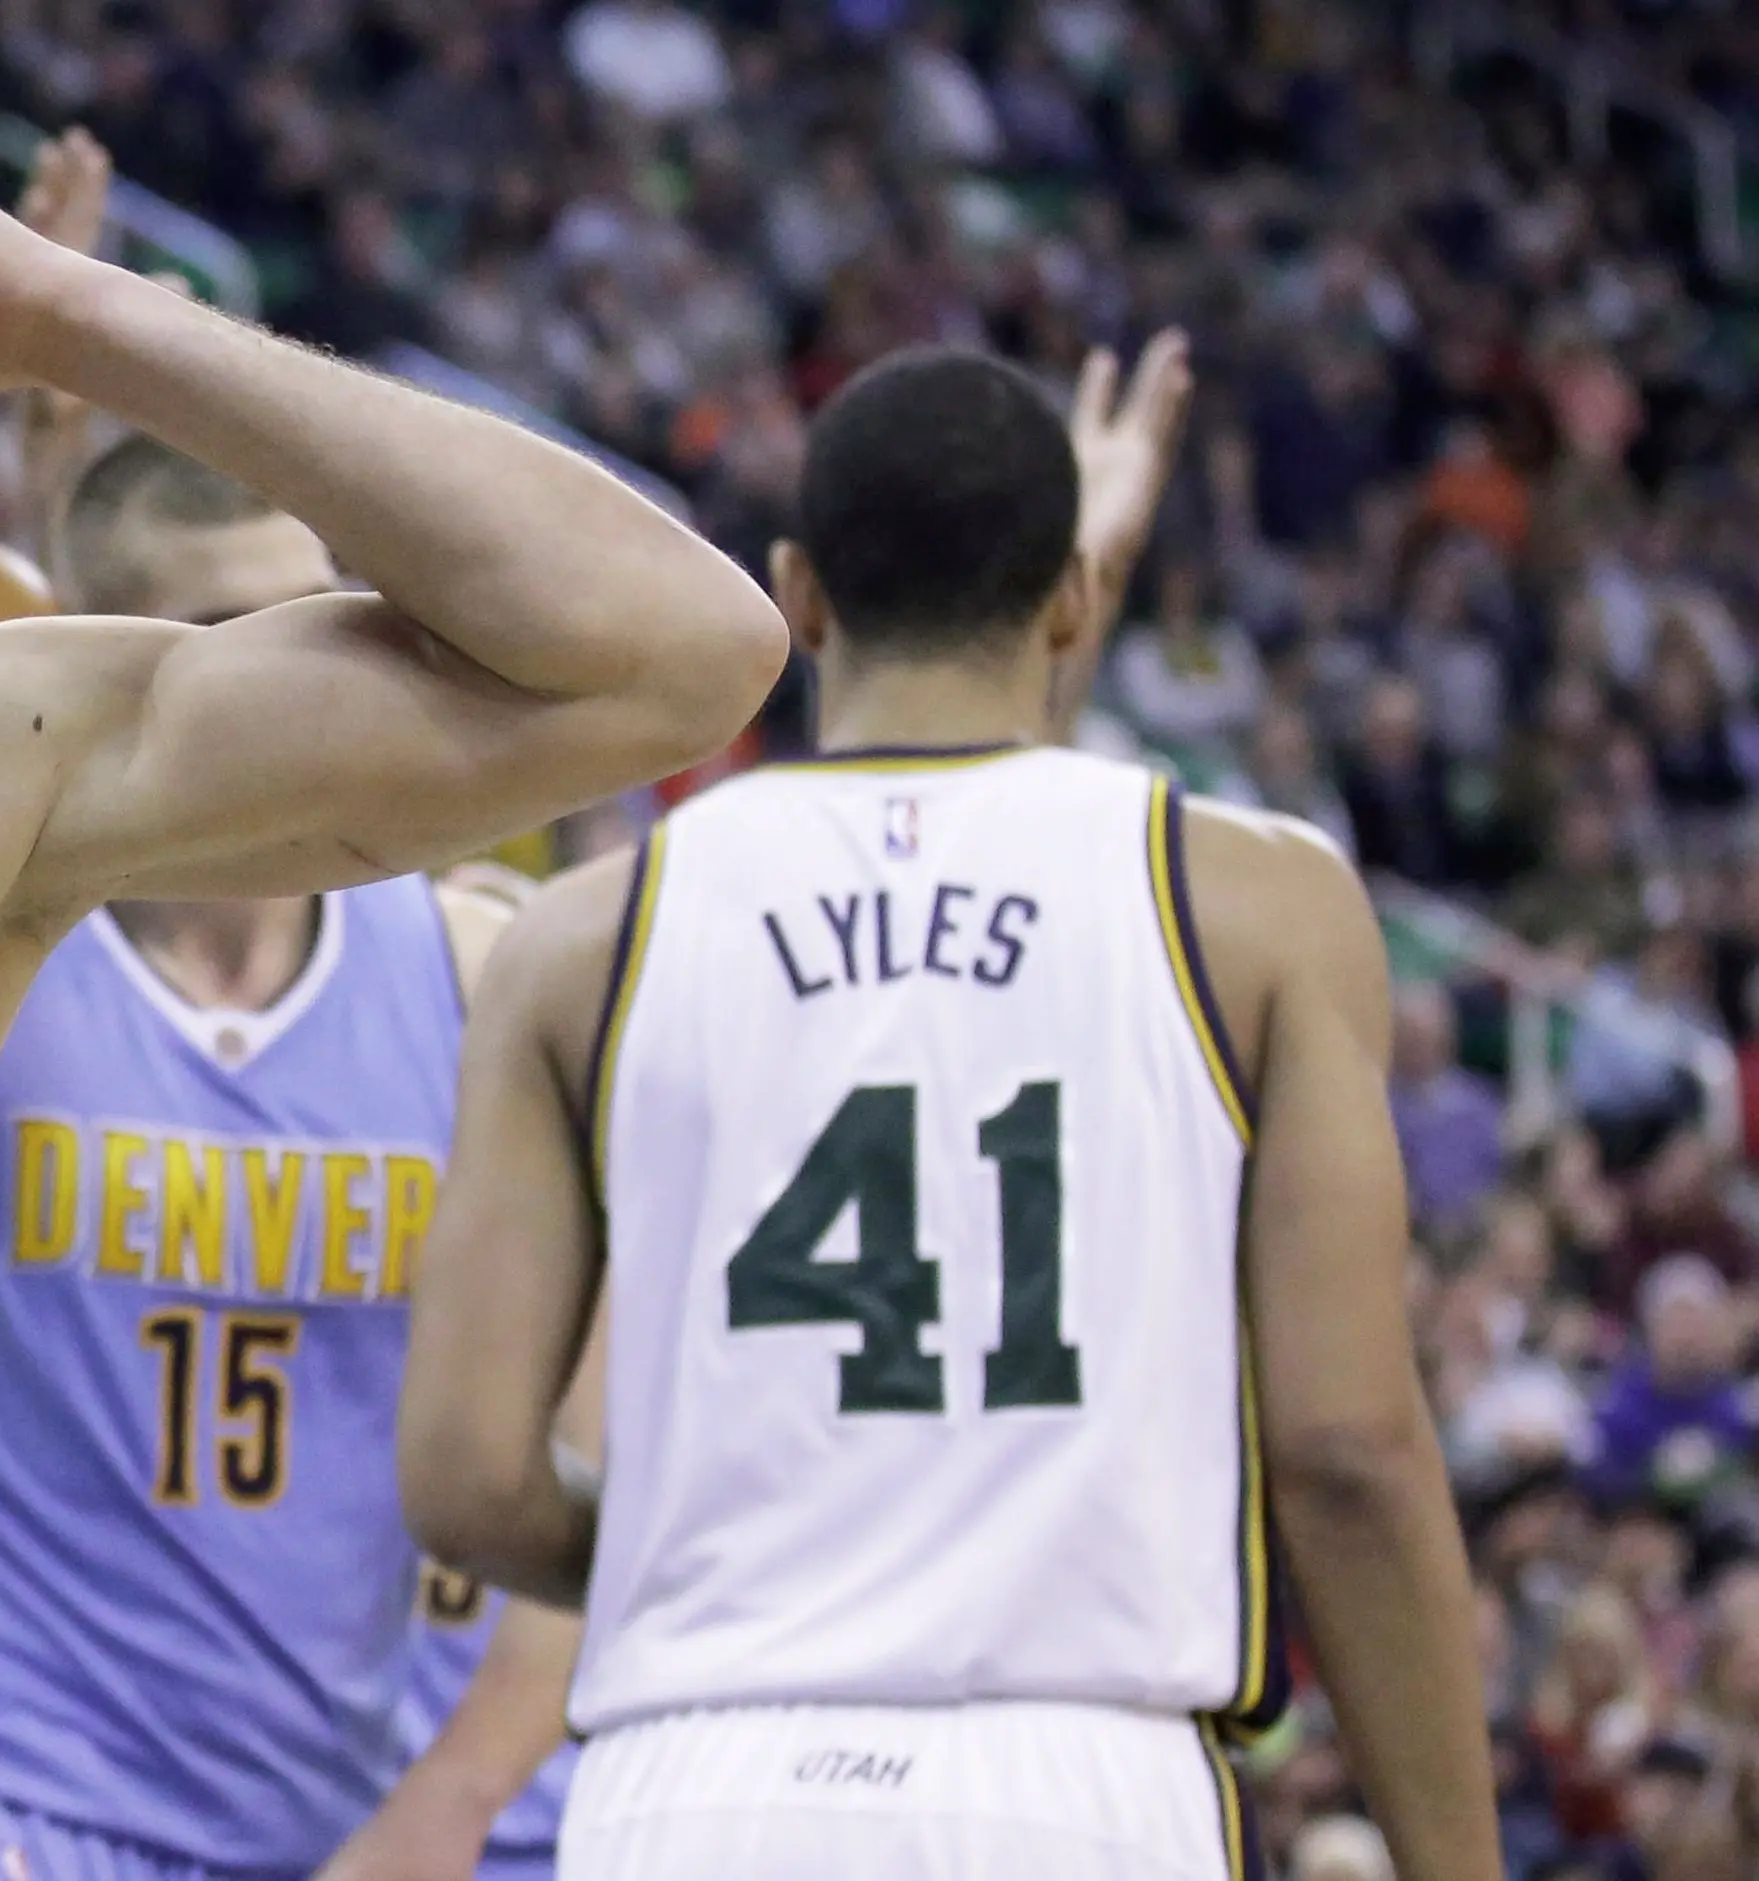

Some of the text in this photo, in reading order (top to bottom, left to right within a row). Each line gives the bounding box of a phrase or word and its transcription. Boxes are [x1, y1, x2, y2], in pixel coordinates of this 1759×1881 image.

[761, 883, 1039, 1002] LYLES
[9, 1115, 442, 1300] DENVER
[726, 1078, 1084, 1416] 41
[141, 1306, 302, 1510] 15
[793, 1748, 913, 1789] UTAH
